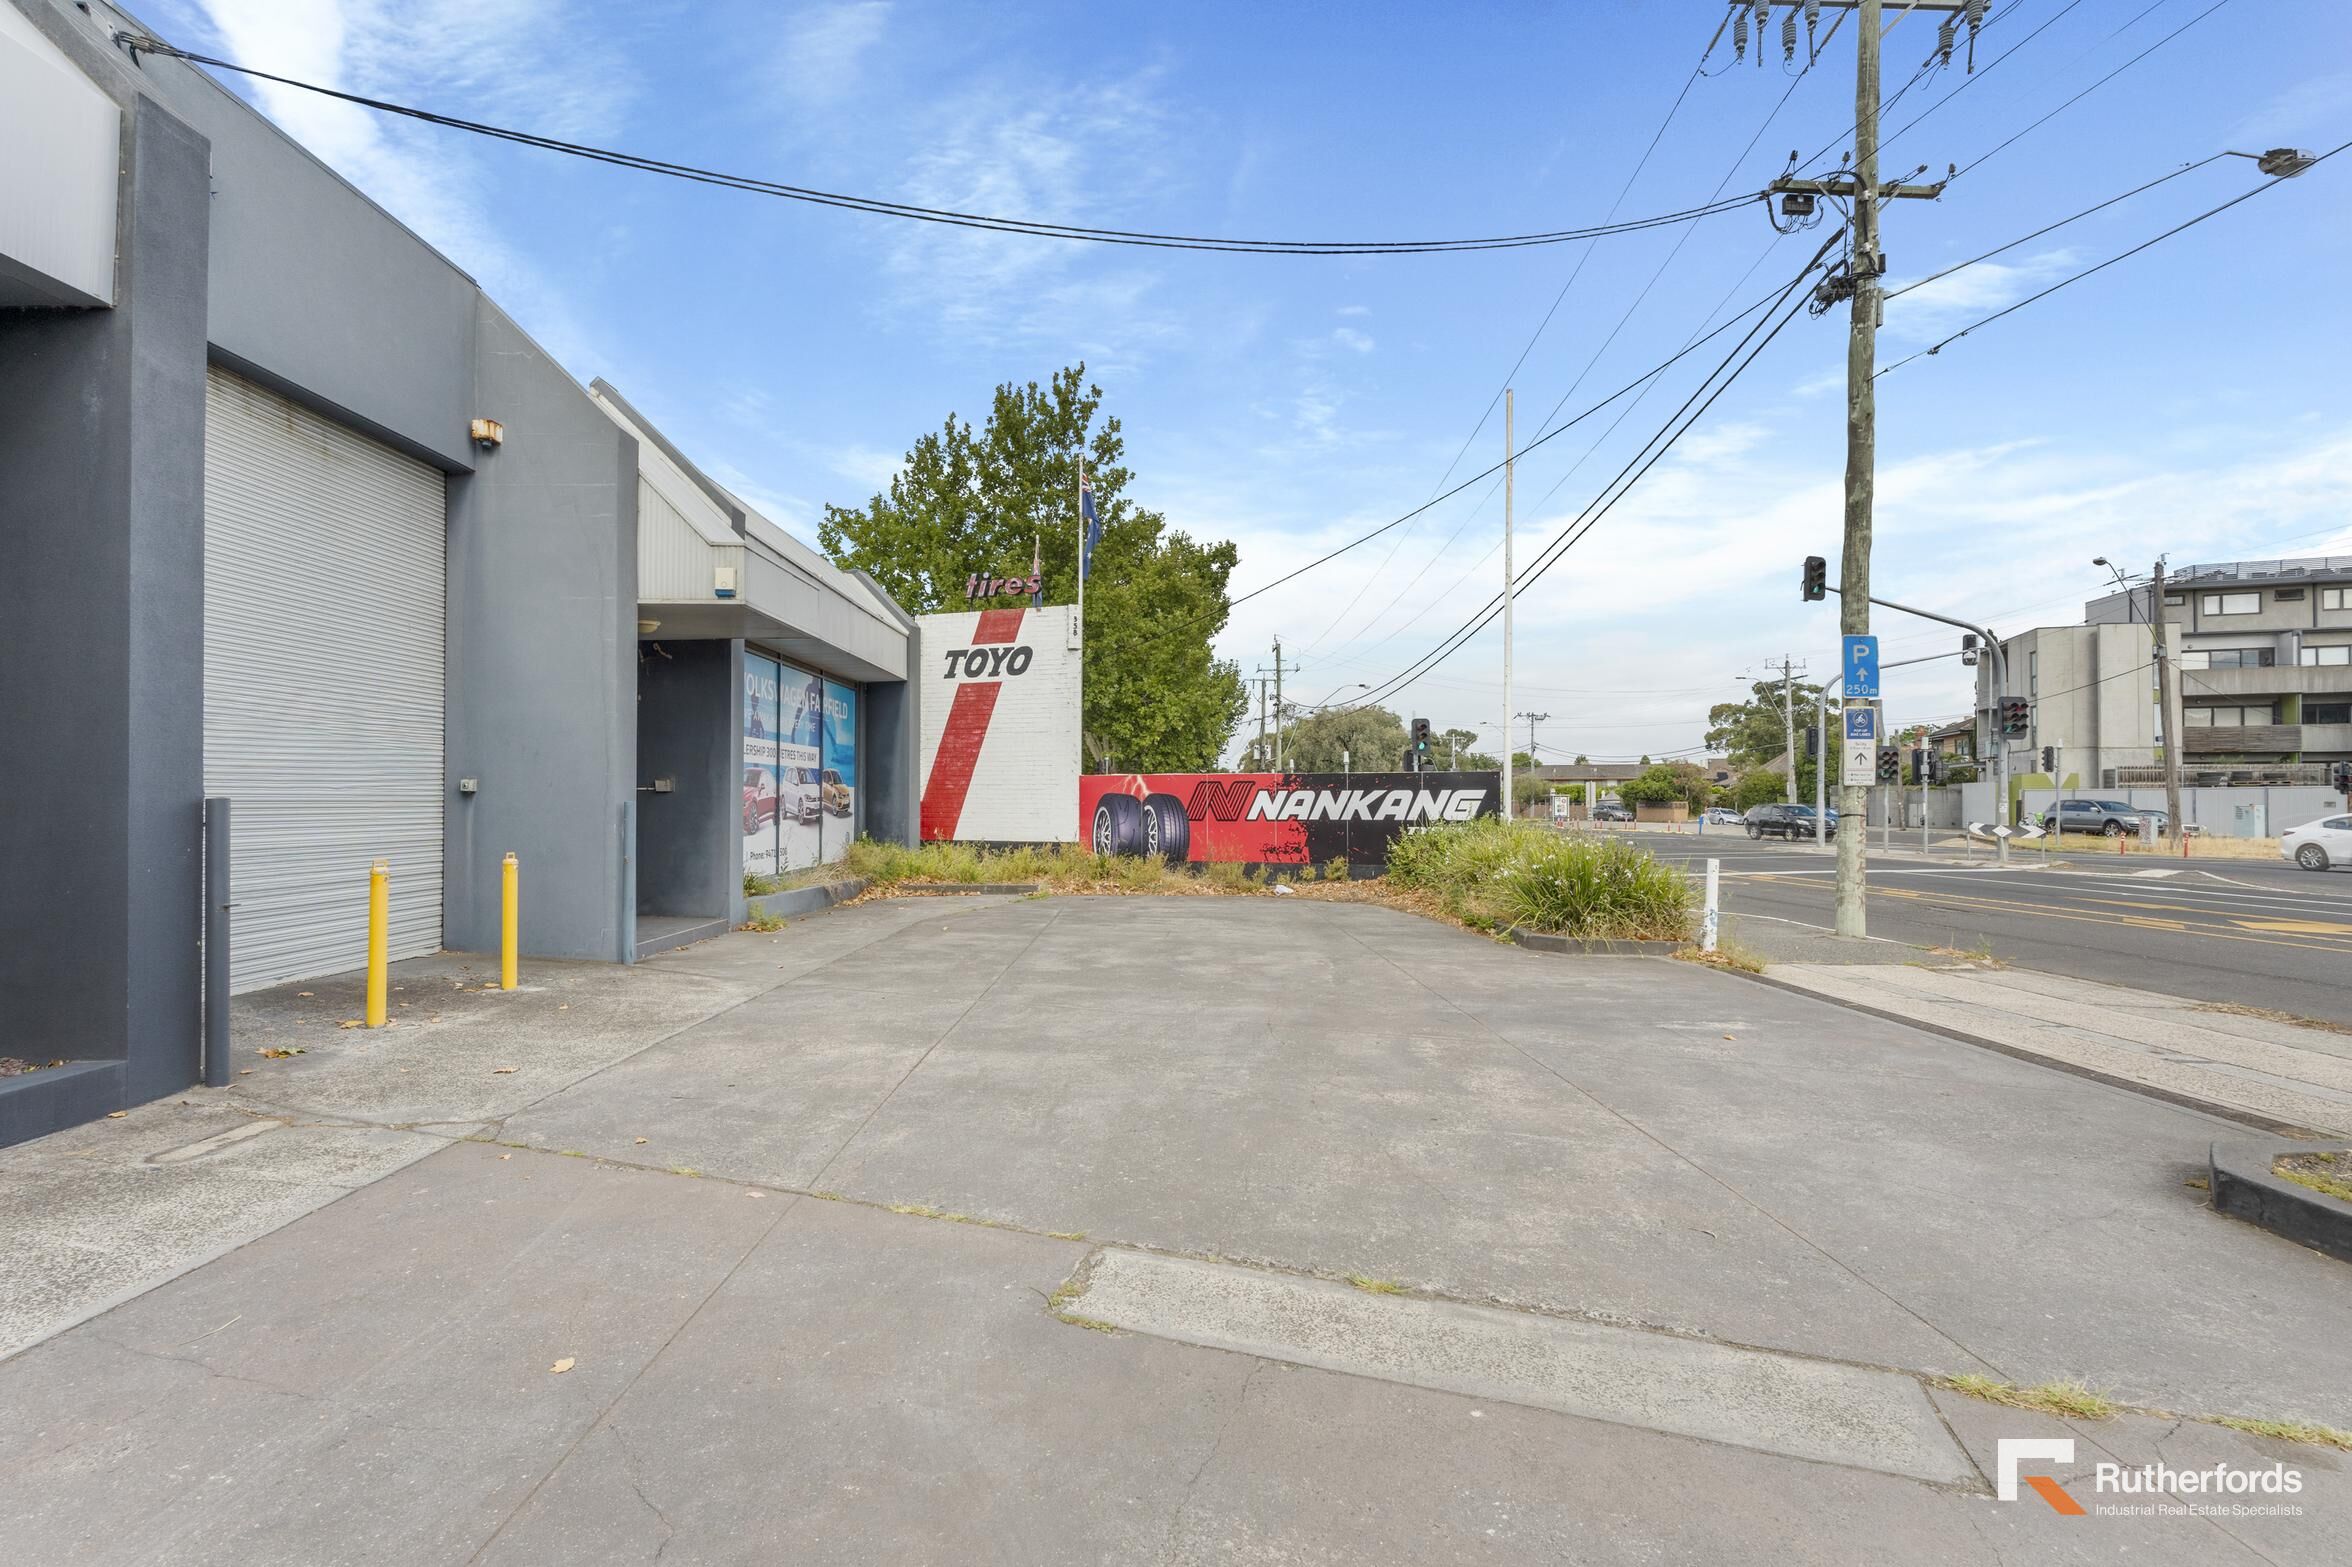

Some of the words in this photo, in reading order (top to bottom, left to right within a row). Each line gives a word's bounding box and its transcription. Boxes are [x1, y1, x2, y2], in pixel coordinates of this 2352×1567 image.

[966, 572, 1042, 598] tires
[943, 646, 1034, 679] TOYO
[1853, 644, 1870, 665] P
[810, 692, 848, 719] FARFIELD
[780, 748, 796, 761] ETRES
[1246, 789, 1488, 821] NANKANG
